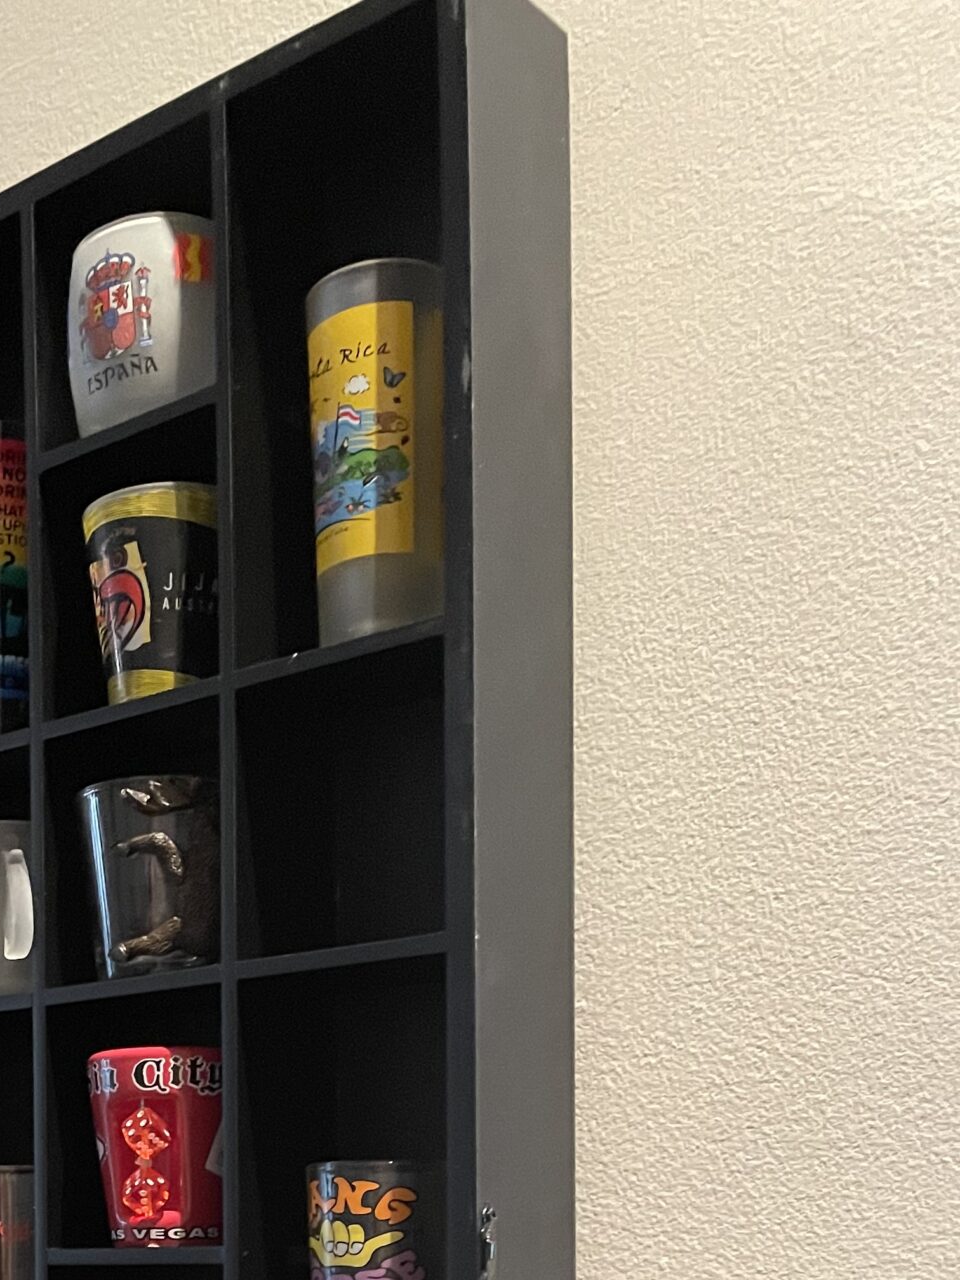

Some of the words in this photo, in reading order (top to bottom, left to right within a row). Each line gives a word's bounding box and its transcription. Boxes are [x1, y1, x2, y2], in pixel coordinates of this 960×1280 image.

[339, 341, 391, 365] Rica
[87, 353, 159, 395] ESPAÑA
[131, 1055, 223, 1096] City
[132, 1226, 219, 1240] VEGAS
